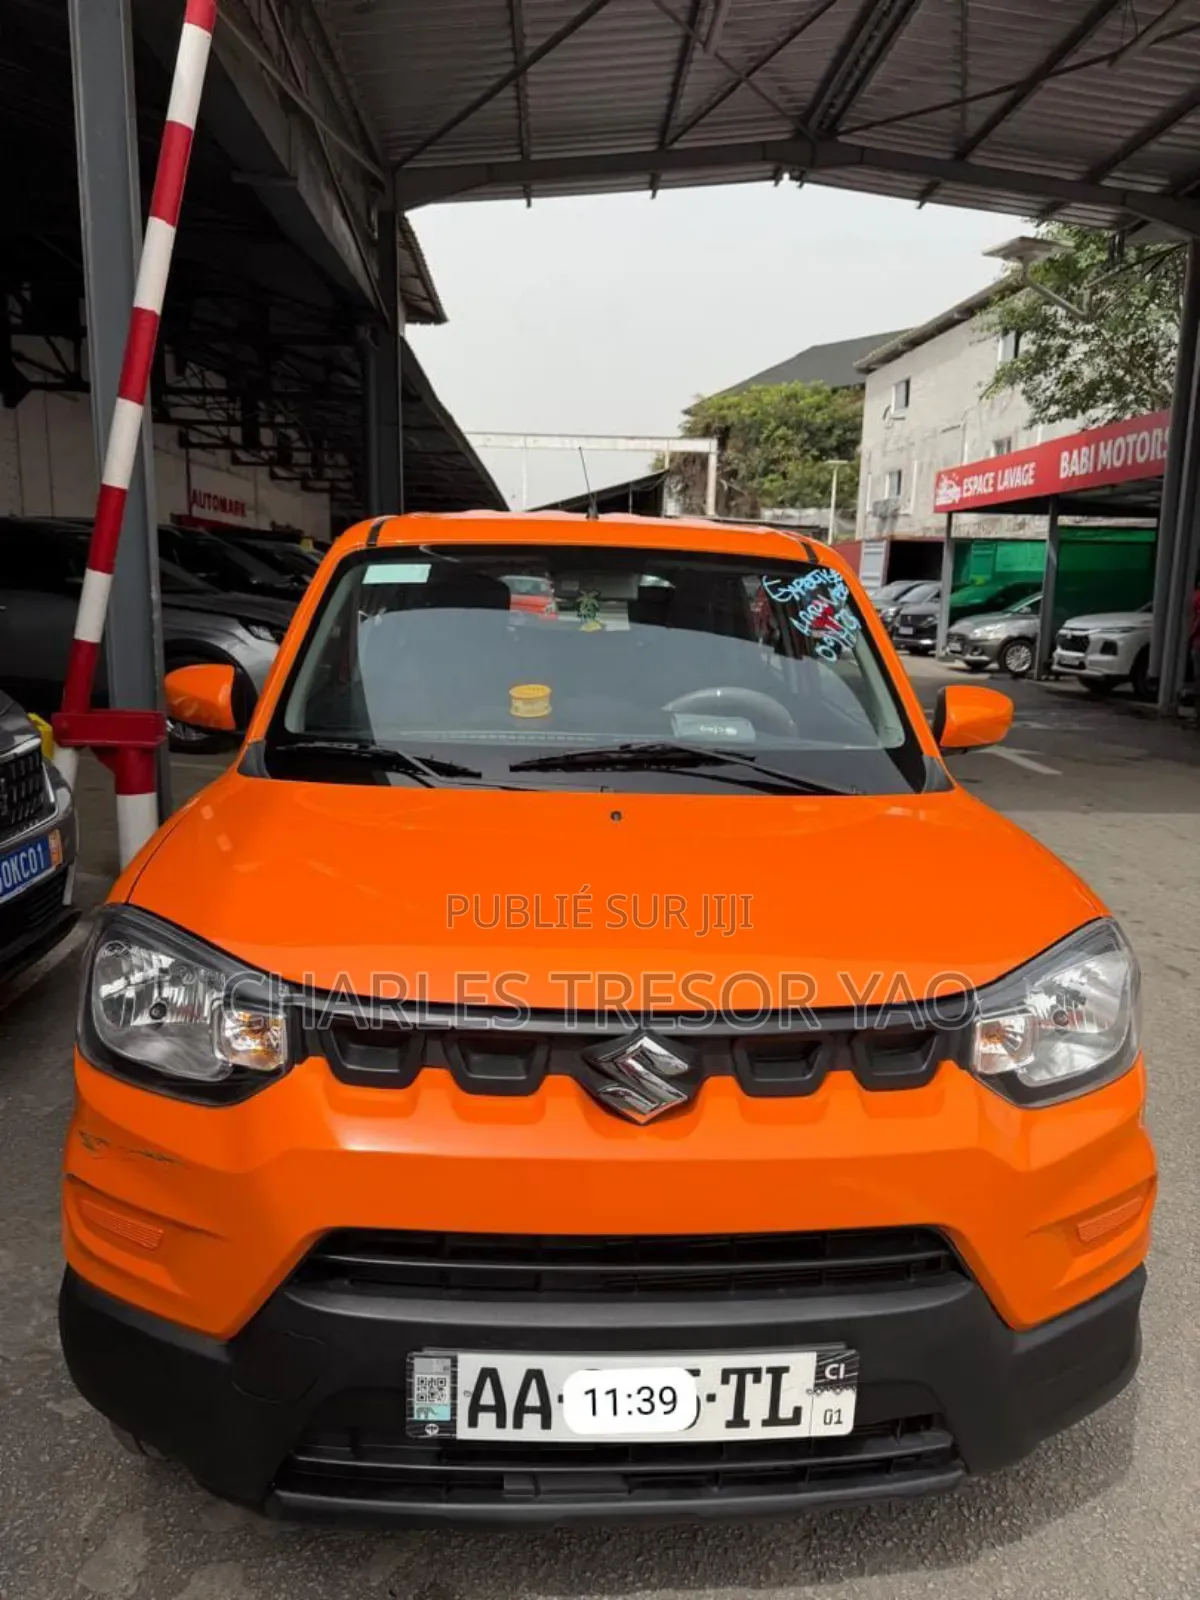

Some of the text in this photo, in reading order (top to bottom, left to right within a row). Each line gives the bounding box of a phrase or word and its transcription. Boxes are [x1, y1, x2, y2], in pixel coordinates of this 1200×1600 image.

[1059, 444, 1094, 479] BABI
[962, 462, 1036, 498] ESPACE LAVAGE
[0, 842, 45, 894] 0KC01
[824, 1363, 846, 1380] CI
[823, 1408, 843, 1426] 01
